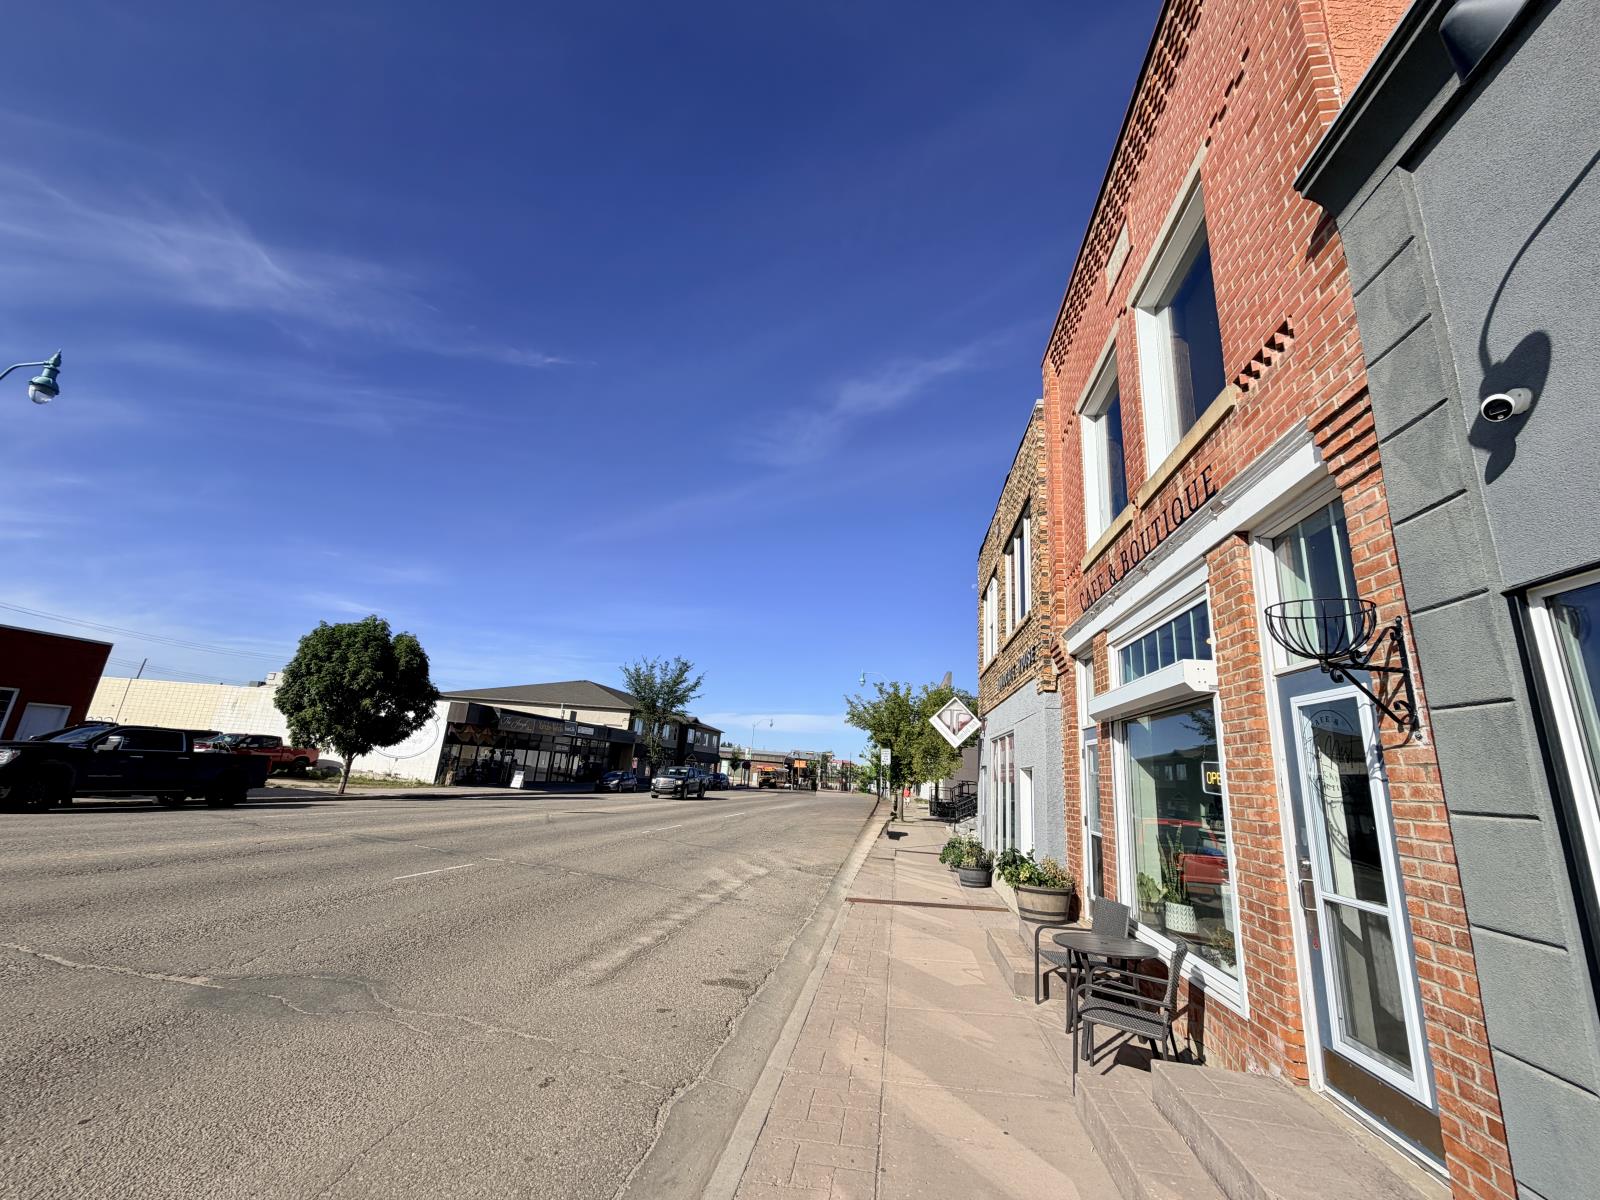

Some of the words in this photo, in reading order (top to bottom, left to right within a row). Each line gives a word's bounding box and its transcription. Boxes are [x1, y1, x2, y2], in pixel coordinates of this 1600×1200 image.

[1079, 574, 1106, 612] CAFE
[1108, 563, 1118, 585] &
[1120, 465, 1219, 576] BOUTIQUE
[1206, 771, 1223, 786] OPE
